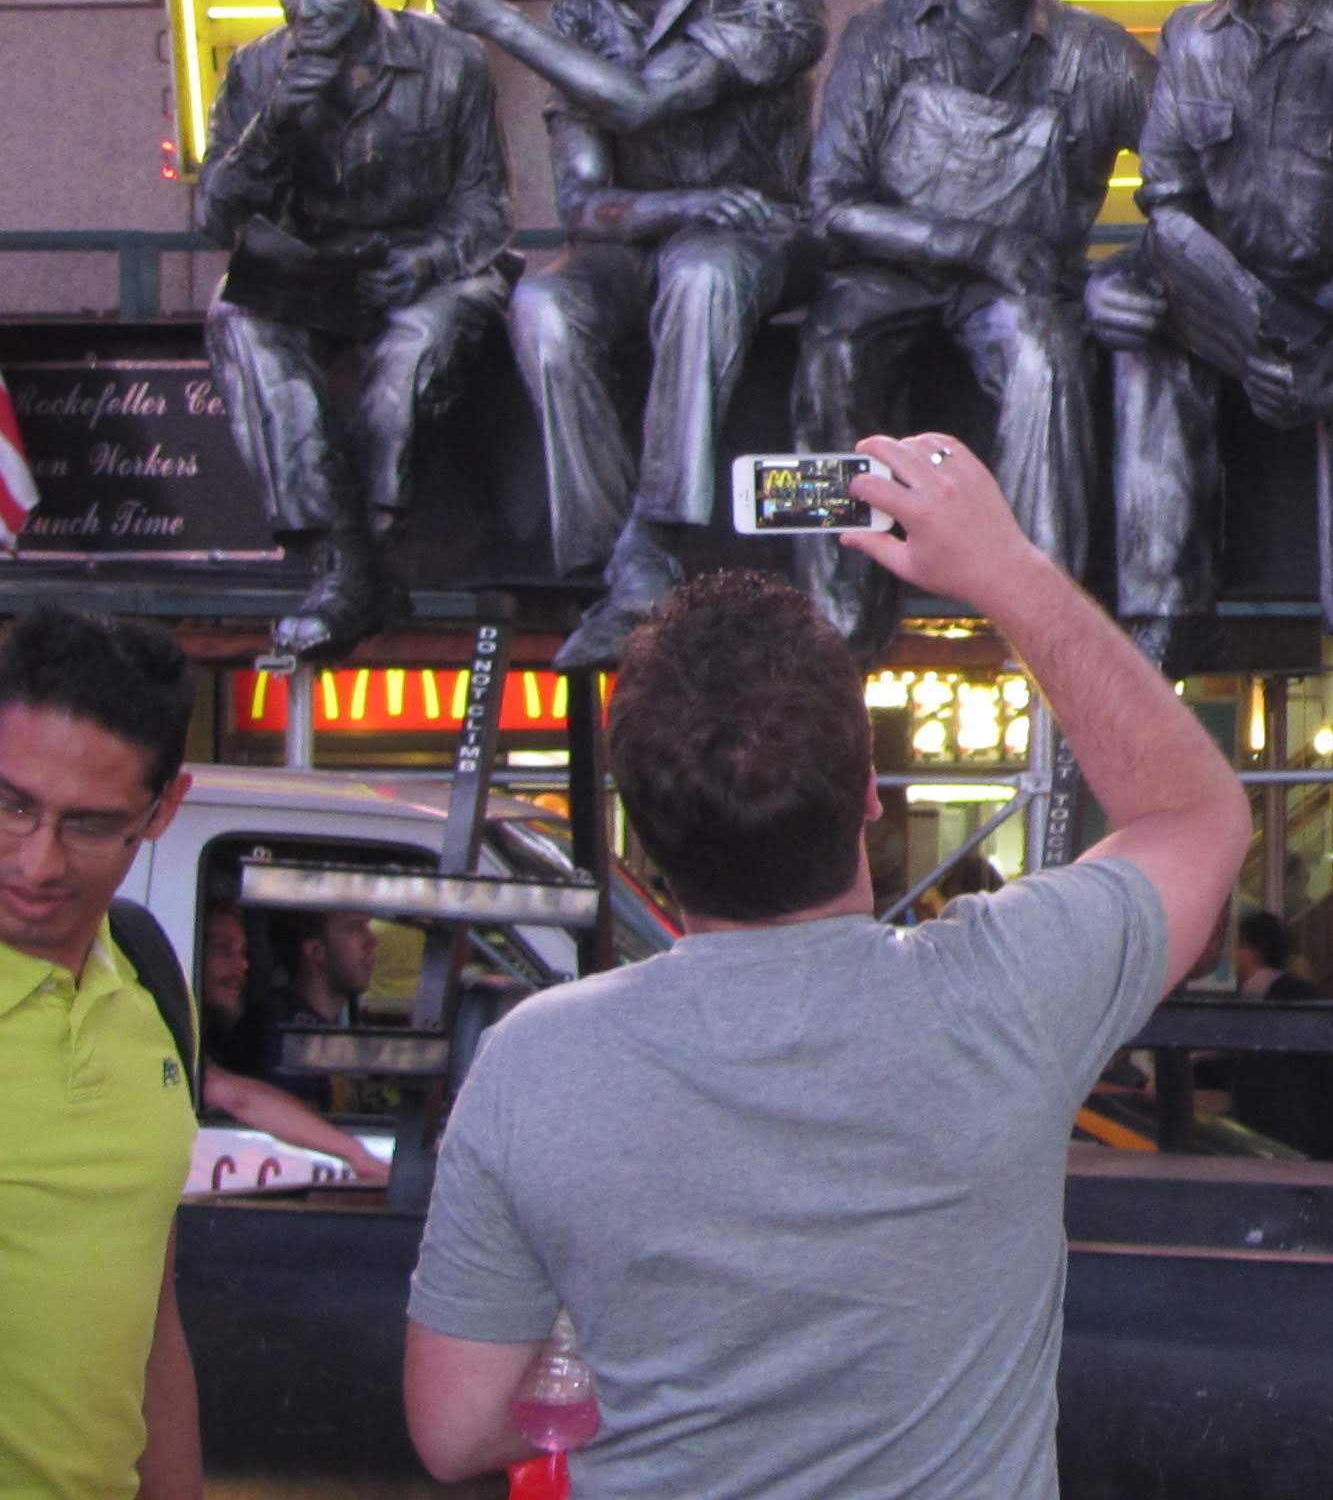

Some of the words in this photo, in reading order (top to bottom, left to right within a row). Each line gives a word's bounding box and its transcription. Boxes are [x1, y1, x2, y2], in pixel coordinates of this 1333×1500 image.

[16, 382, 167, 429] Rockefeller
[185, 379, 227, 416] Ce
[89, 441, 198, 477] Workers
[110, 501, 185, 536] Time
[476, 627, 497, 653] DO
[471, 660, 492, 700] NOT
[458, 704, 485, 772] CLIMB
[1044, 793, 1071, 865] TOUCH
